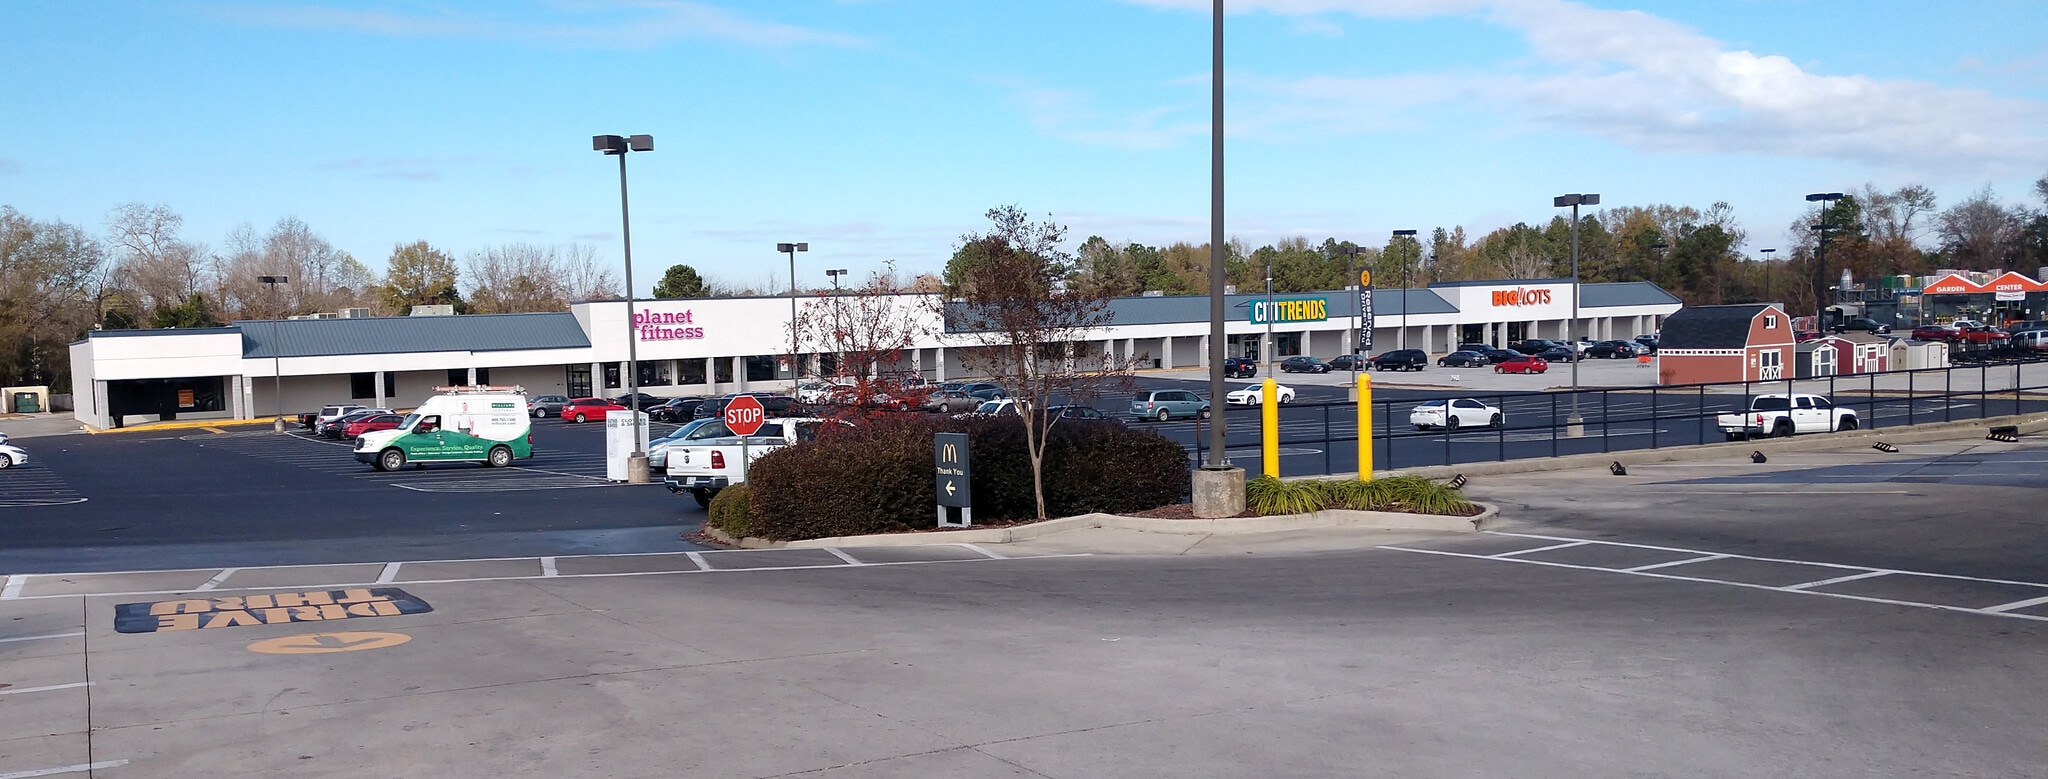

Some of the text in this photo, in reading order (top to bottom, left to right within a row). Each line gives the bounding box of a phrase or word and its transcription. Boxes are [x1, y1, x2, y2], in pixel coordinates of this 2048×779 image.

[633, 309, 692, 328] planet
[641, 325, 703, 340] fitness
[728, 408, 761, 424] STOP
[937, 467, 964, 476] Thank You
[150, 588, 388, 615] THRU
[156, 600, 401, 632] DRIVE
